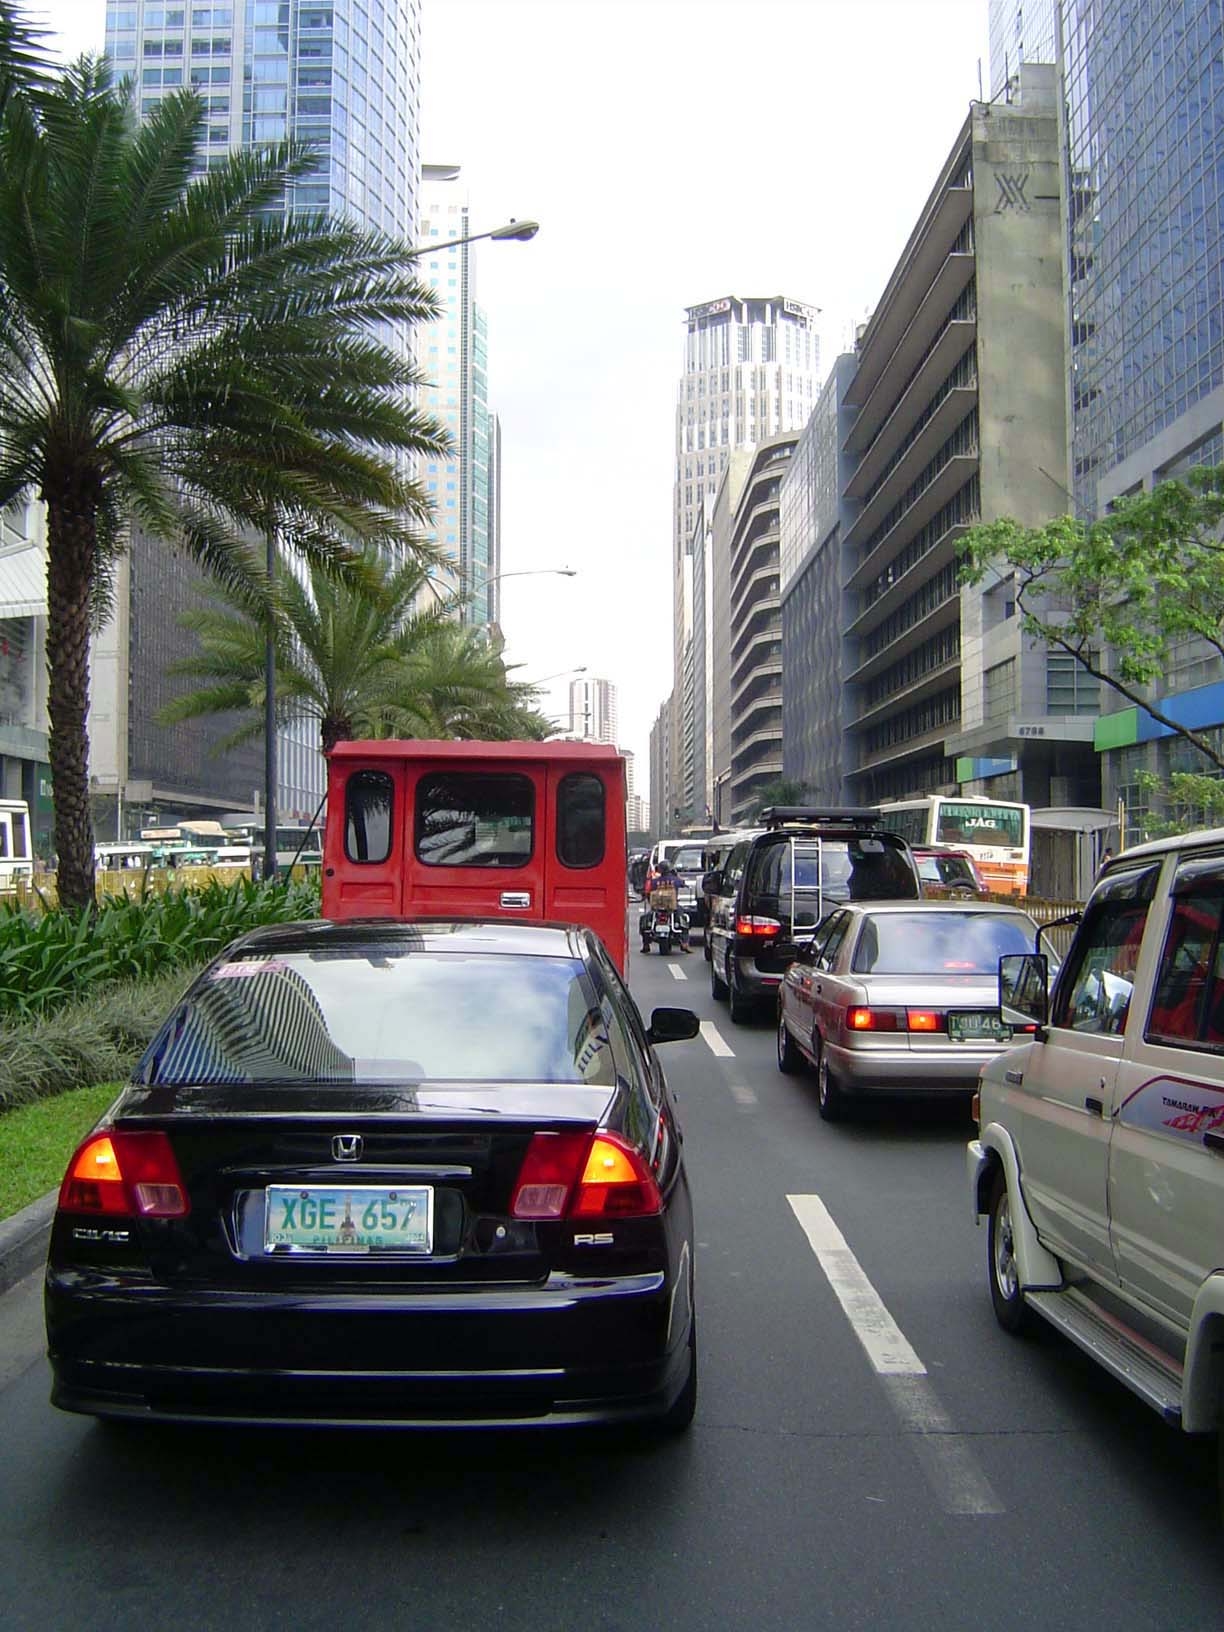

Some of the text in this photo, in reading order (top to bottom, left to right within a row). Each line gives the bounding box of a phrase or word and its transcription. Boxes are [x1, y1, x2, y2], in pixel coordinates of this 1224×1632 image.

[965, 816, 996, 829] JAG
[1162, 1096, 1200, 1113] TAMARAW
[281, 1198, 416, 1231] XGE 657
[573, 1233, 614, 1245] RS
